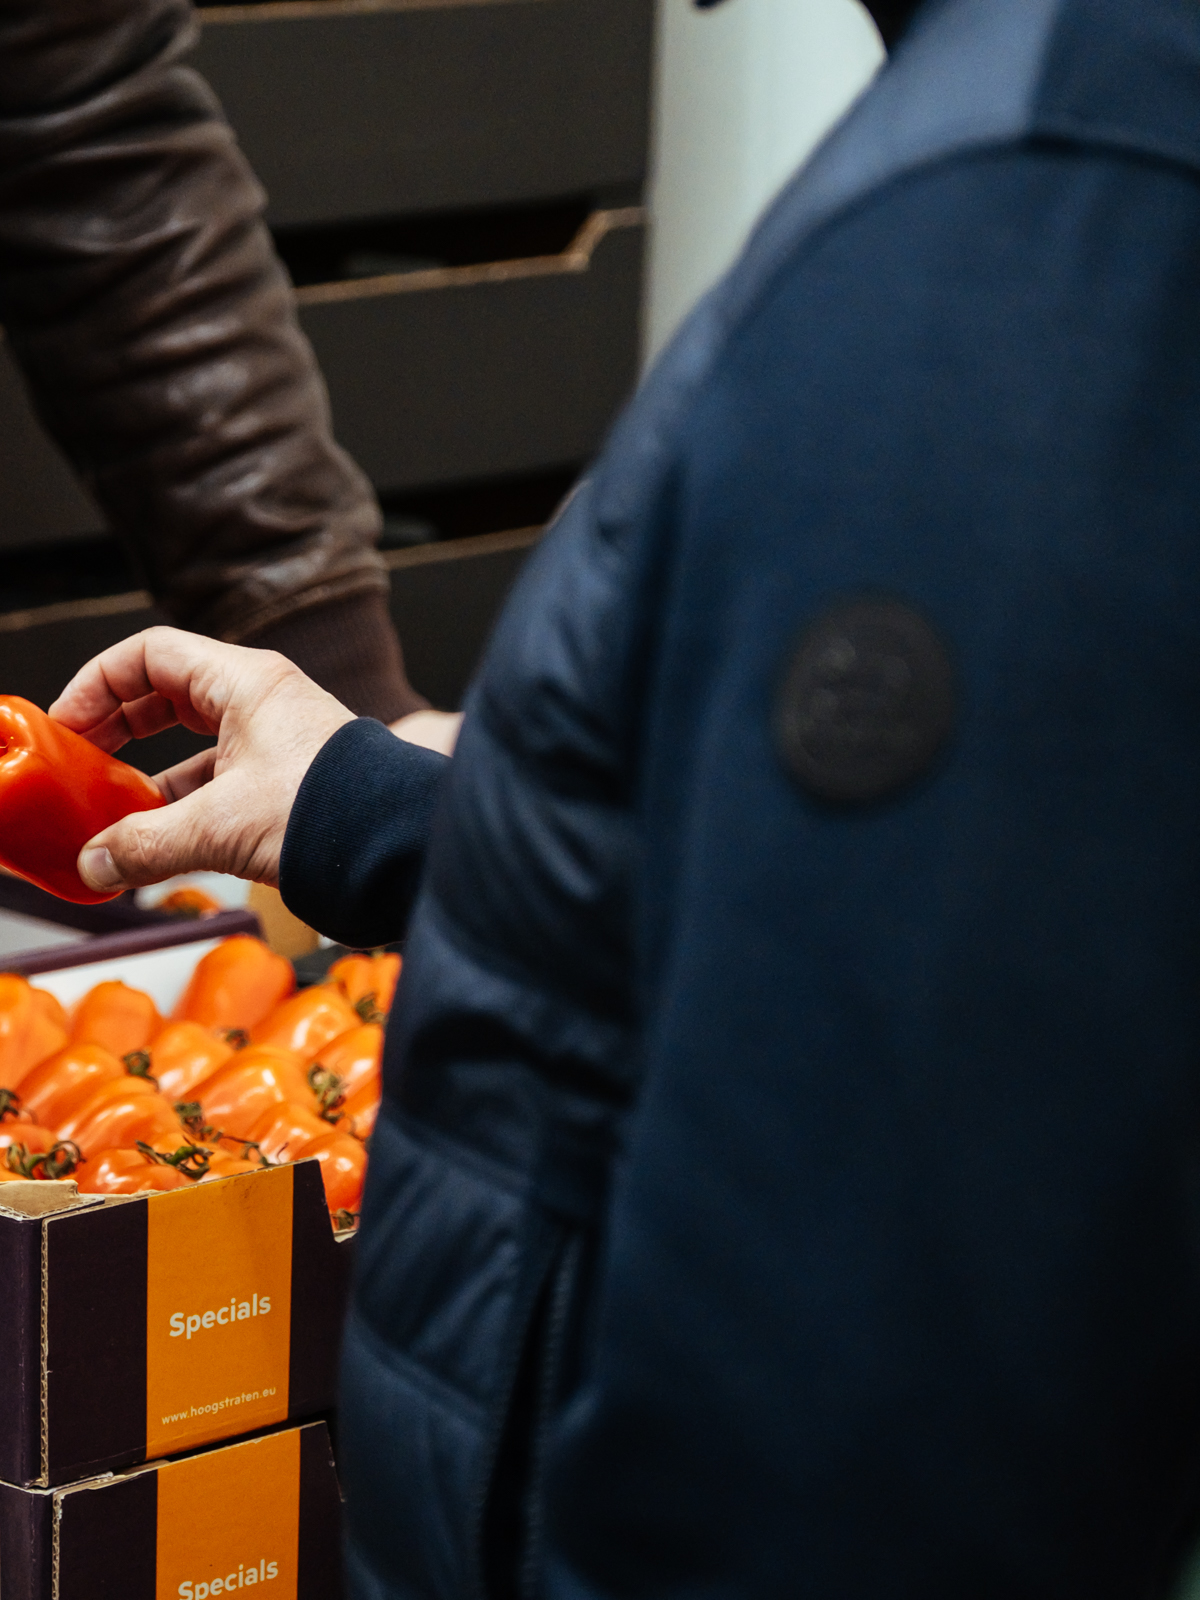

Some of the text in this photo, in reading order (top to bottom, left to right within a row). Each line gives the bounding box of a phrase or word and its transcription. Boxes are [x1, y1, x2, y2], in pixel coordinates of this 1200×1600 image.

[169, 1293, 272, 1340] Specials
[161, 1386, 277, 1425] www.hoogstraten.eu
[177, 1558, 279, 1600] Specials
